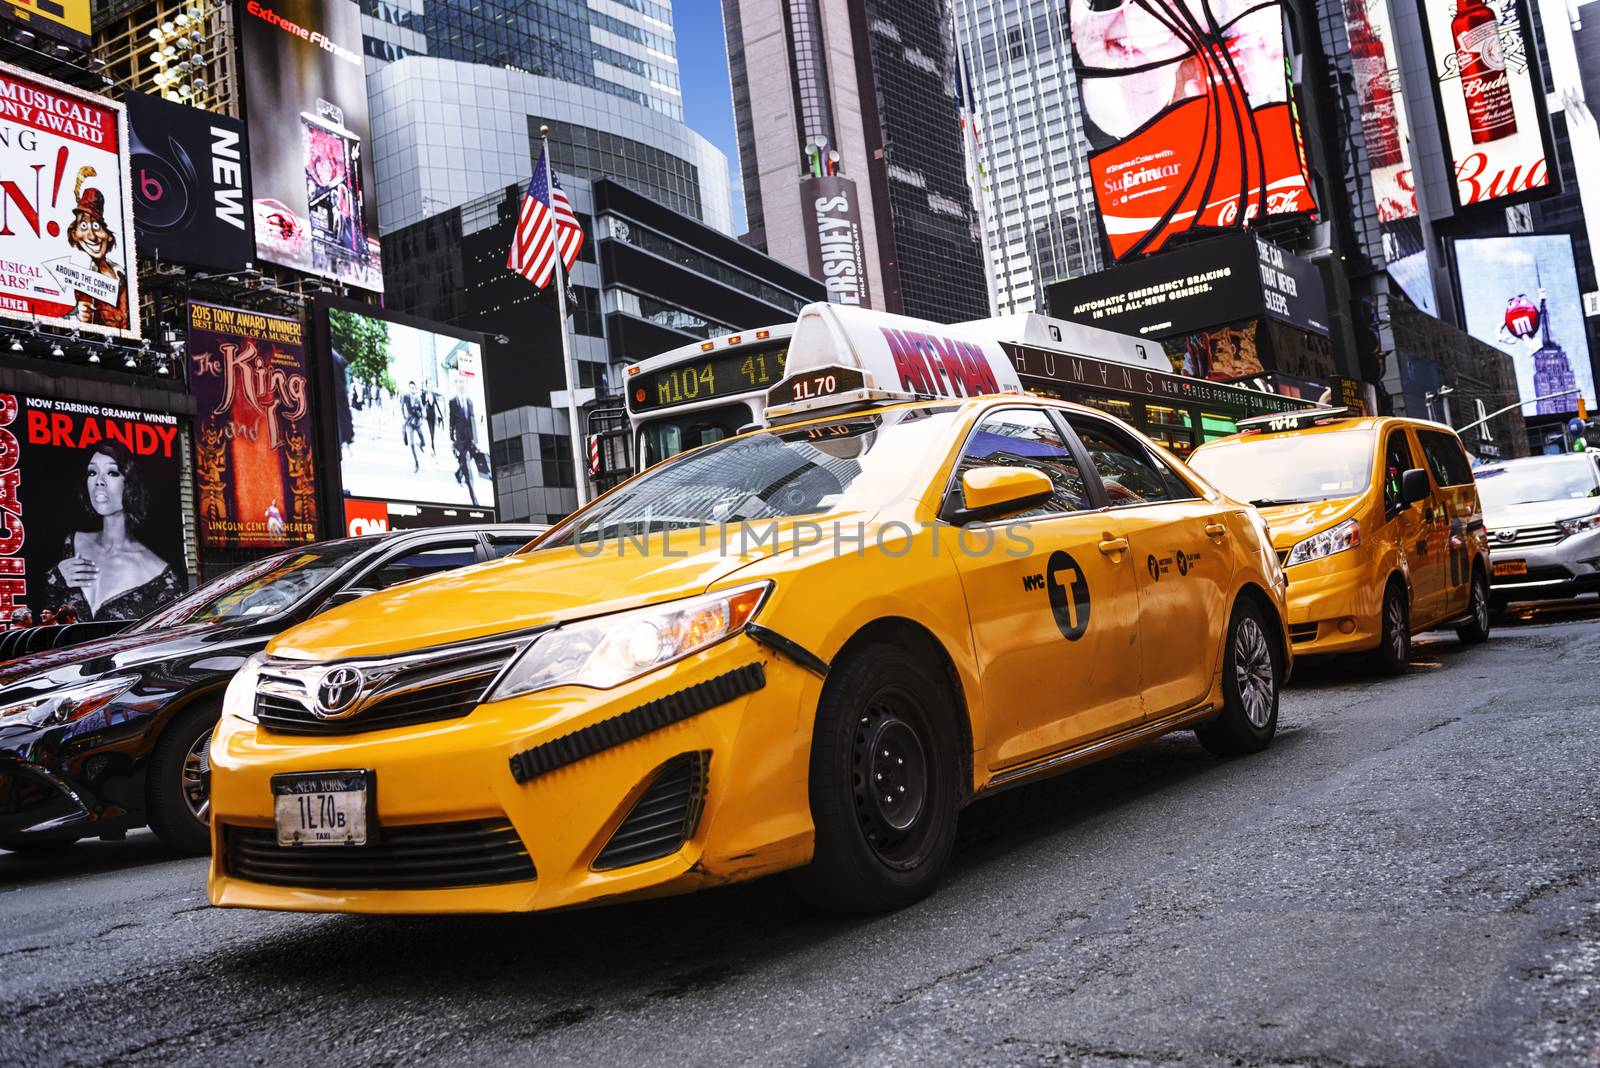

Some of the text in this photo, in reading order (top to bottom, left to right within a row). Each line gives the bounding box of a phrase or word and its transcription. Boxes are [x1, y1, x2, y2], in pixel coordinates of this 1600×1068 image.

[246, 0, 309, 40] Extreme
[0, 80, 102, 128] MUSICAL!
[35, 112, 103, 143] AWARD
[210, 126, 246, 231] NEW
[815, 196, 860, 304] ERSHEY'S
[852, 223, 866, 298] MILK CHOCOLATE
[1256, 239, 1284, 269] THE CAR
[56, 264, 116, 293] AROUND THE CORNER
[87, 286, 107, 297] STREET
[1073, 267, 1231, 314] AUTOMATIC EMERGENCY BRAKING
[1260, 263, 1298, 297] THAT NEVER
[1093, 283, 1213, 319] IN THE ALL-NEW GENESIS.
[192, 304, 302, 336] 2015 TONY AWARD WINNER!
[192, 319, 212, 330] BEST
[215, 323, 248, 336] REVIVAL
[250, 328, 259, 337] OF
[270, 332, 302, 345] MUSICAL
[192, 352, 222, 377] The
[879, 326, 1001, 398] ANT-MAN
[214, 341, 307, 421] King
[657, 362, 715, 405] M104
[740, 353, 770, 385] 41
[793, 375, 836, 401] 1L70
[26, 397, 178, 425] NOW STARRING GRAMMY WINNER
[1161, 380, 1179, 393] NEW
[1182, 383, 1211, 399] SERIES
[1213, 389, 1249, 406] PREMIERE
[1251, 396, 1263, 408] SUN
[1266, 399, 1281, 412] JUNE
[27, 409, 178, 458] BRANDY
[225, 416, 260, 443] and
[1268, 418, 1299, 431] 1V14
[208, 521, 243, 531] LINCOLN
[282, 523, 313, 532] HEATER
[1022, 573, 1046, 592] NYC
[296, 779, 345, 793] NEW YORK
